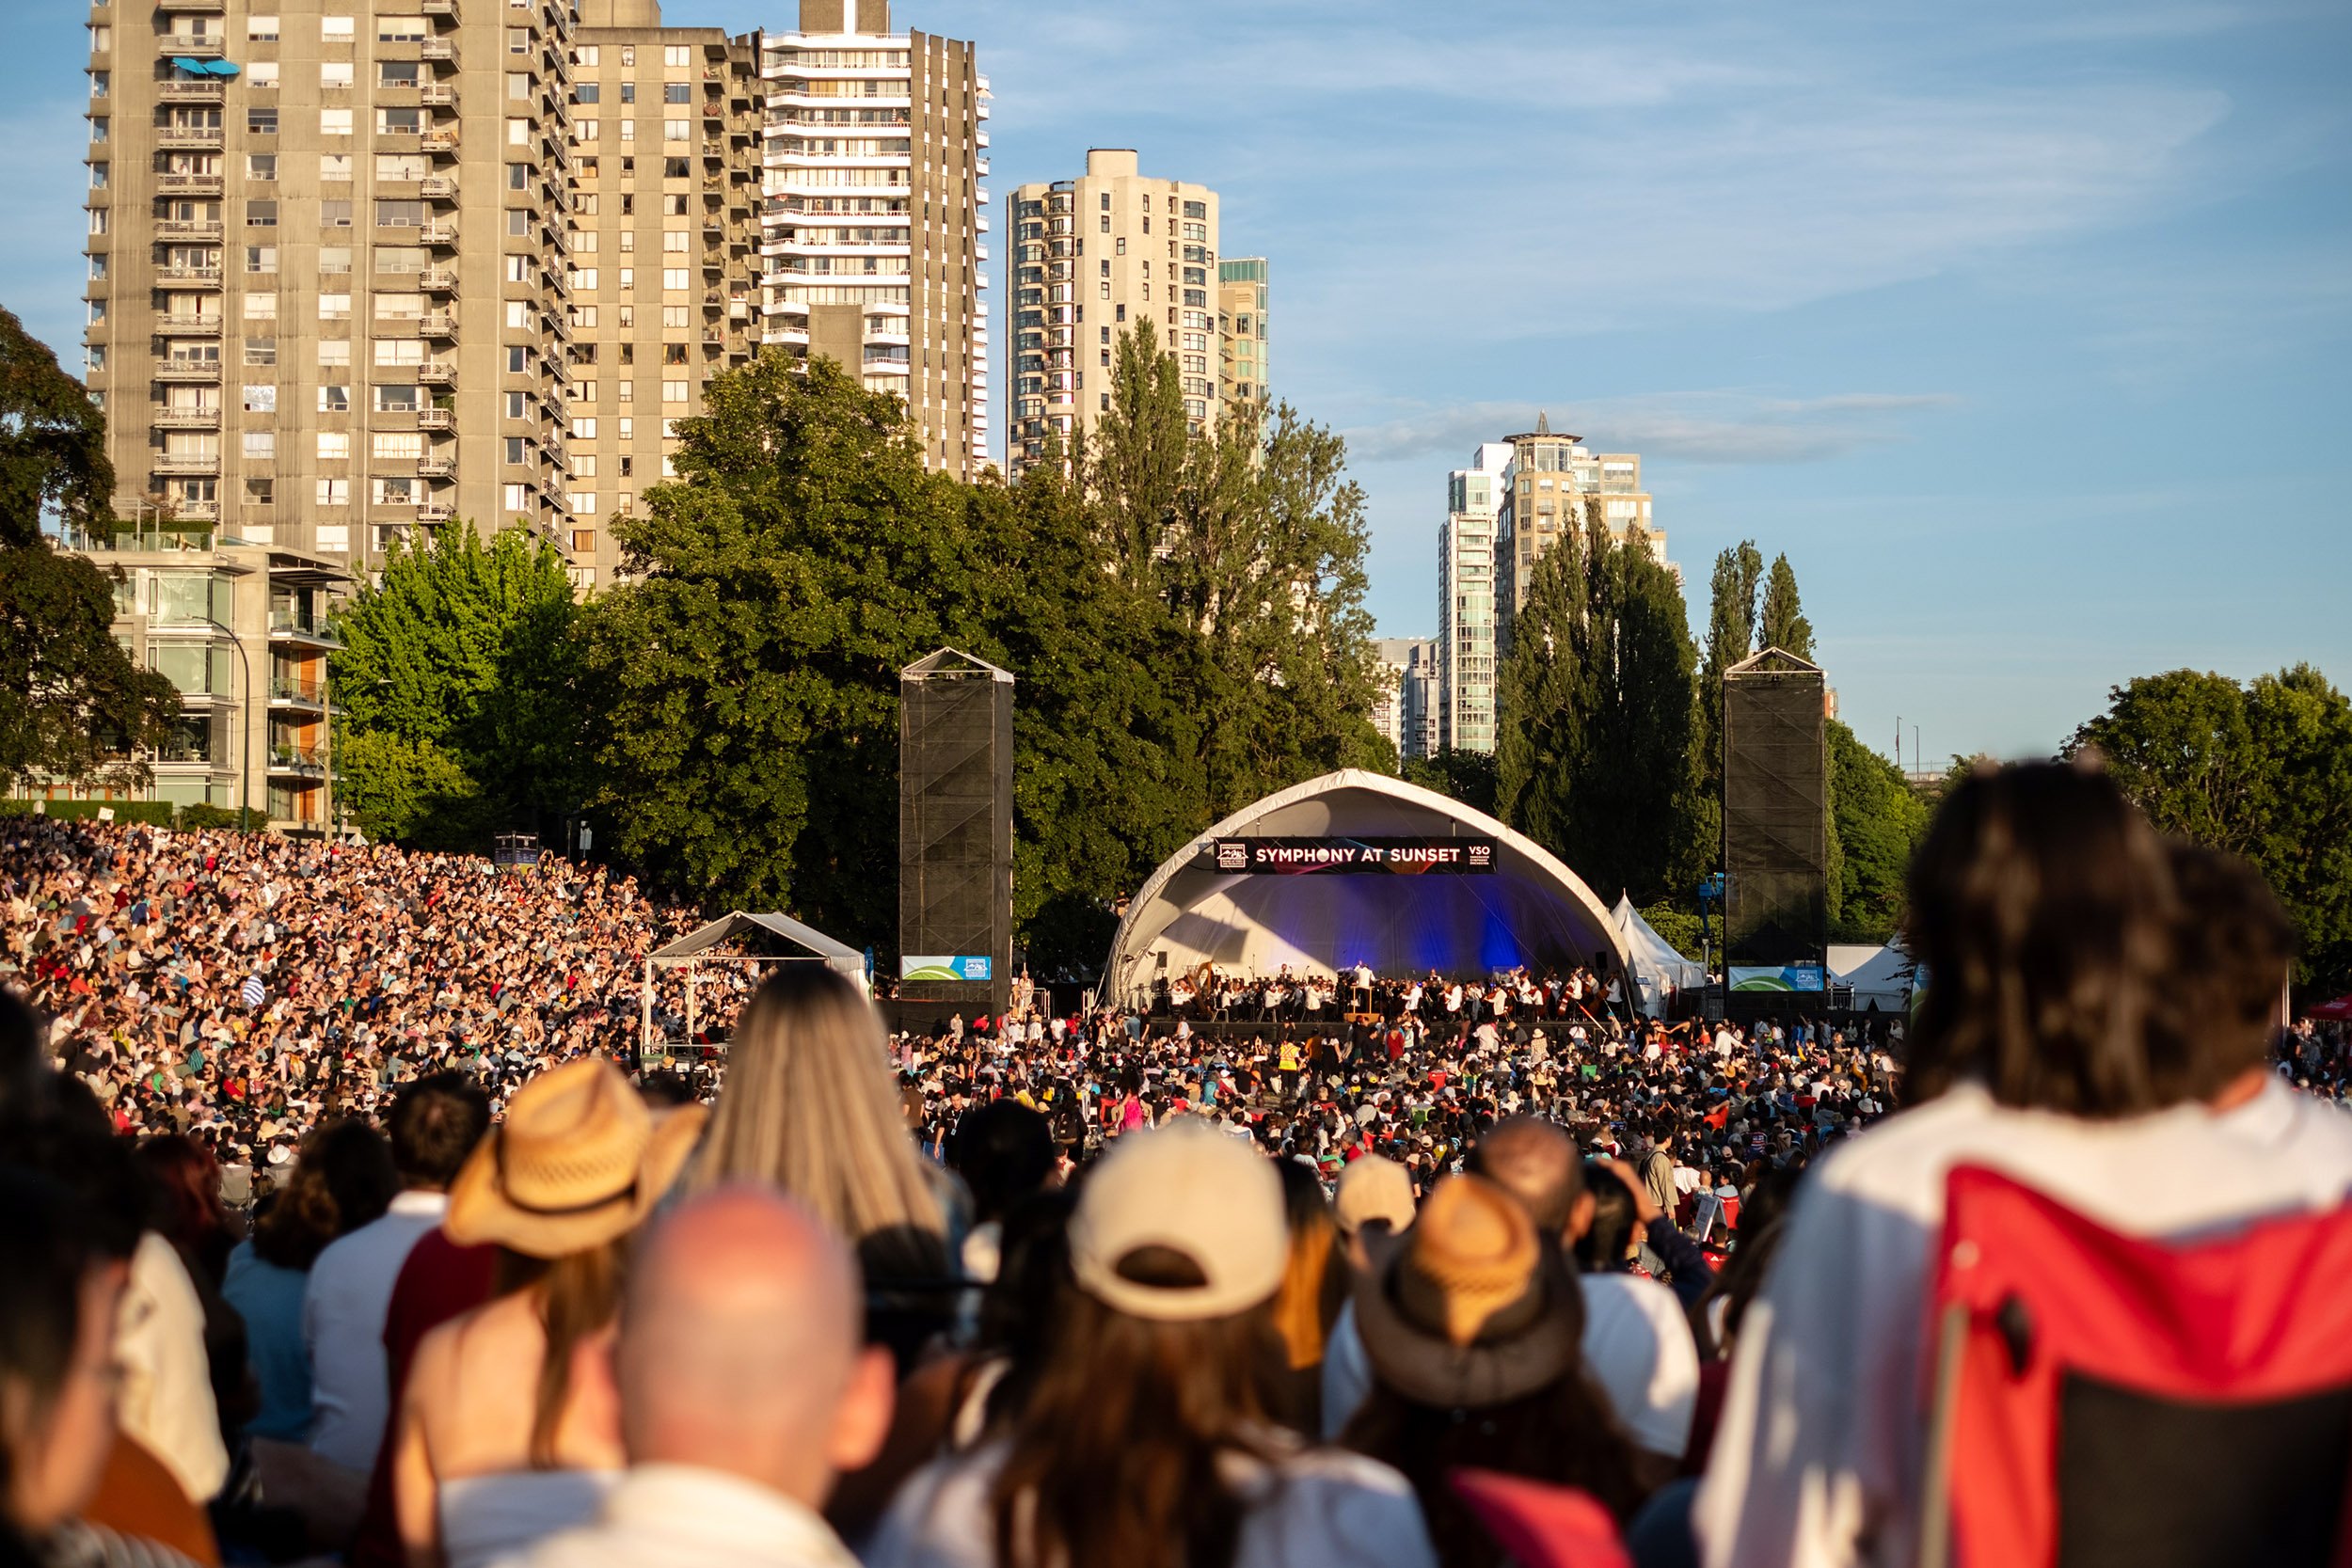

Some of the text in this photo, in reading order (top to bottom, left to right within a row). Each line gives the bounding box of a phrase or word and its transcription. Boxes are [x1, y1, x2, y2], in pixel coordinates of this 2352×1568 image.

[1256, 848, 1355, 863] SYMPHONY
[1360, 848, 1384, 863] AT
[1390, 848, 1461, 863] SUNSET
[1469, 846, 1490, 855] VSO
